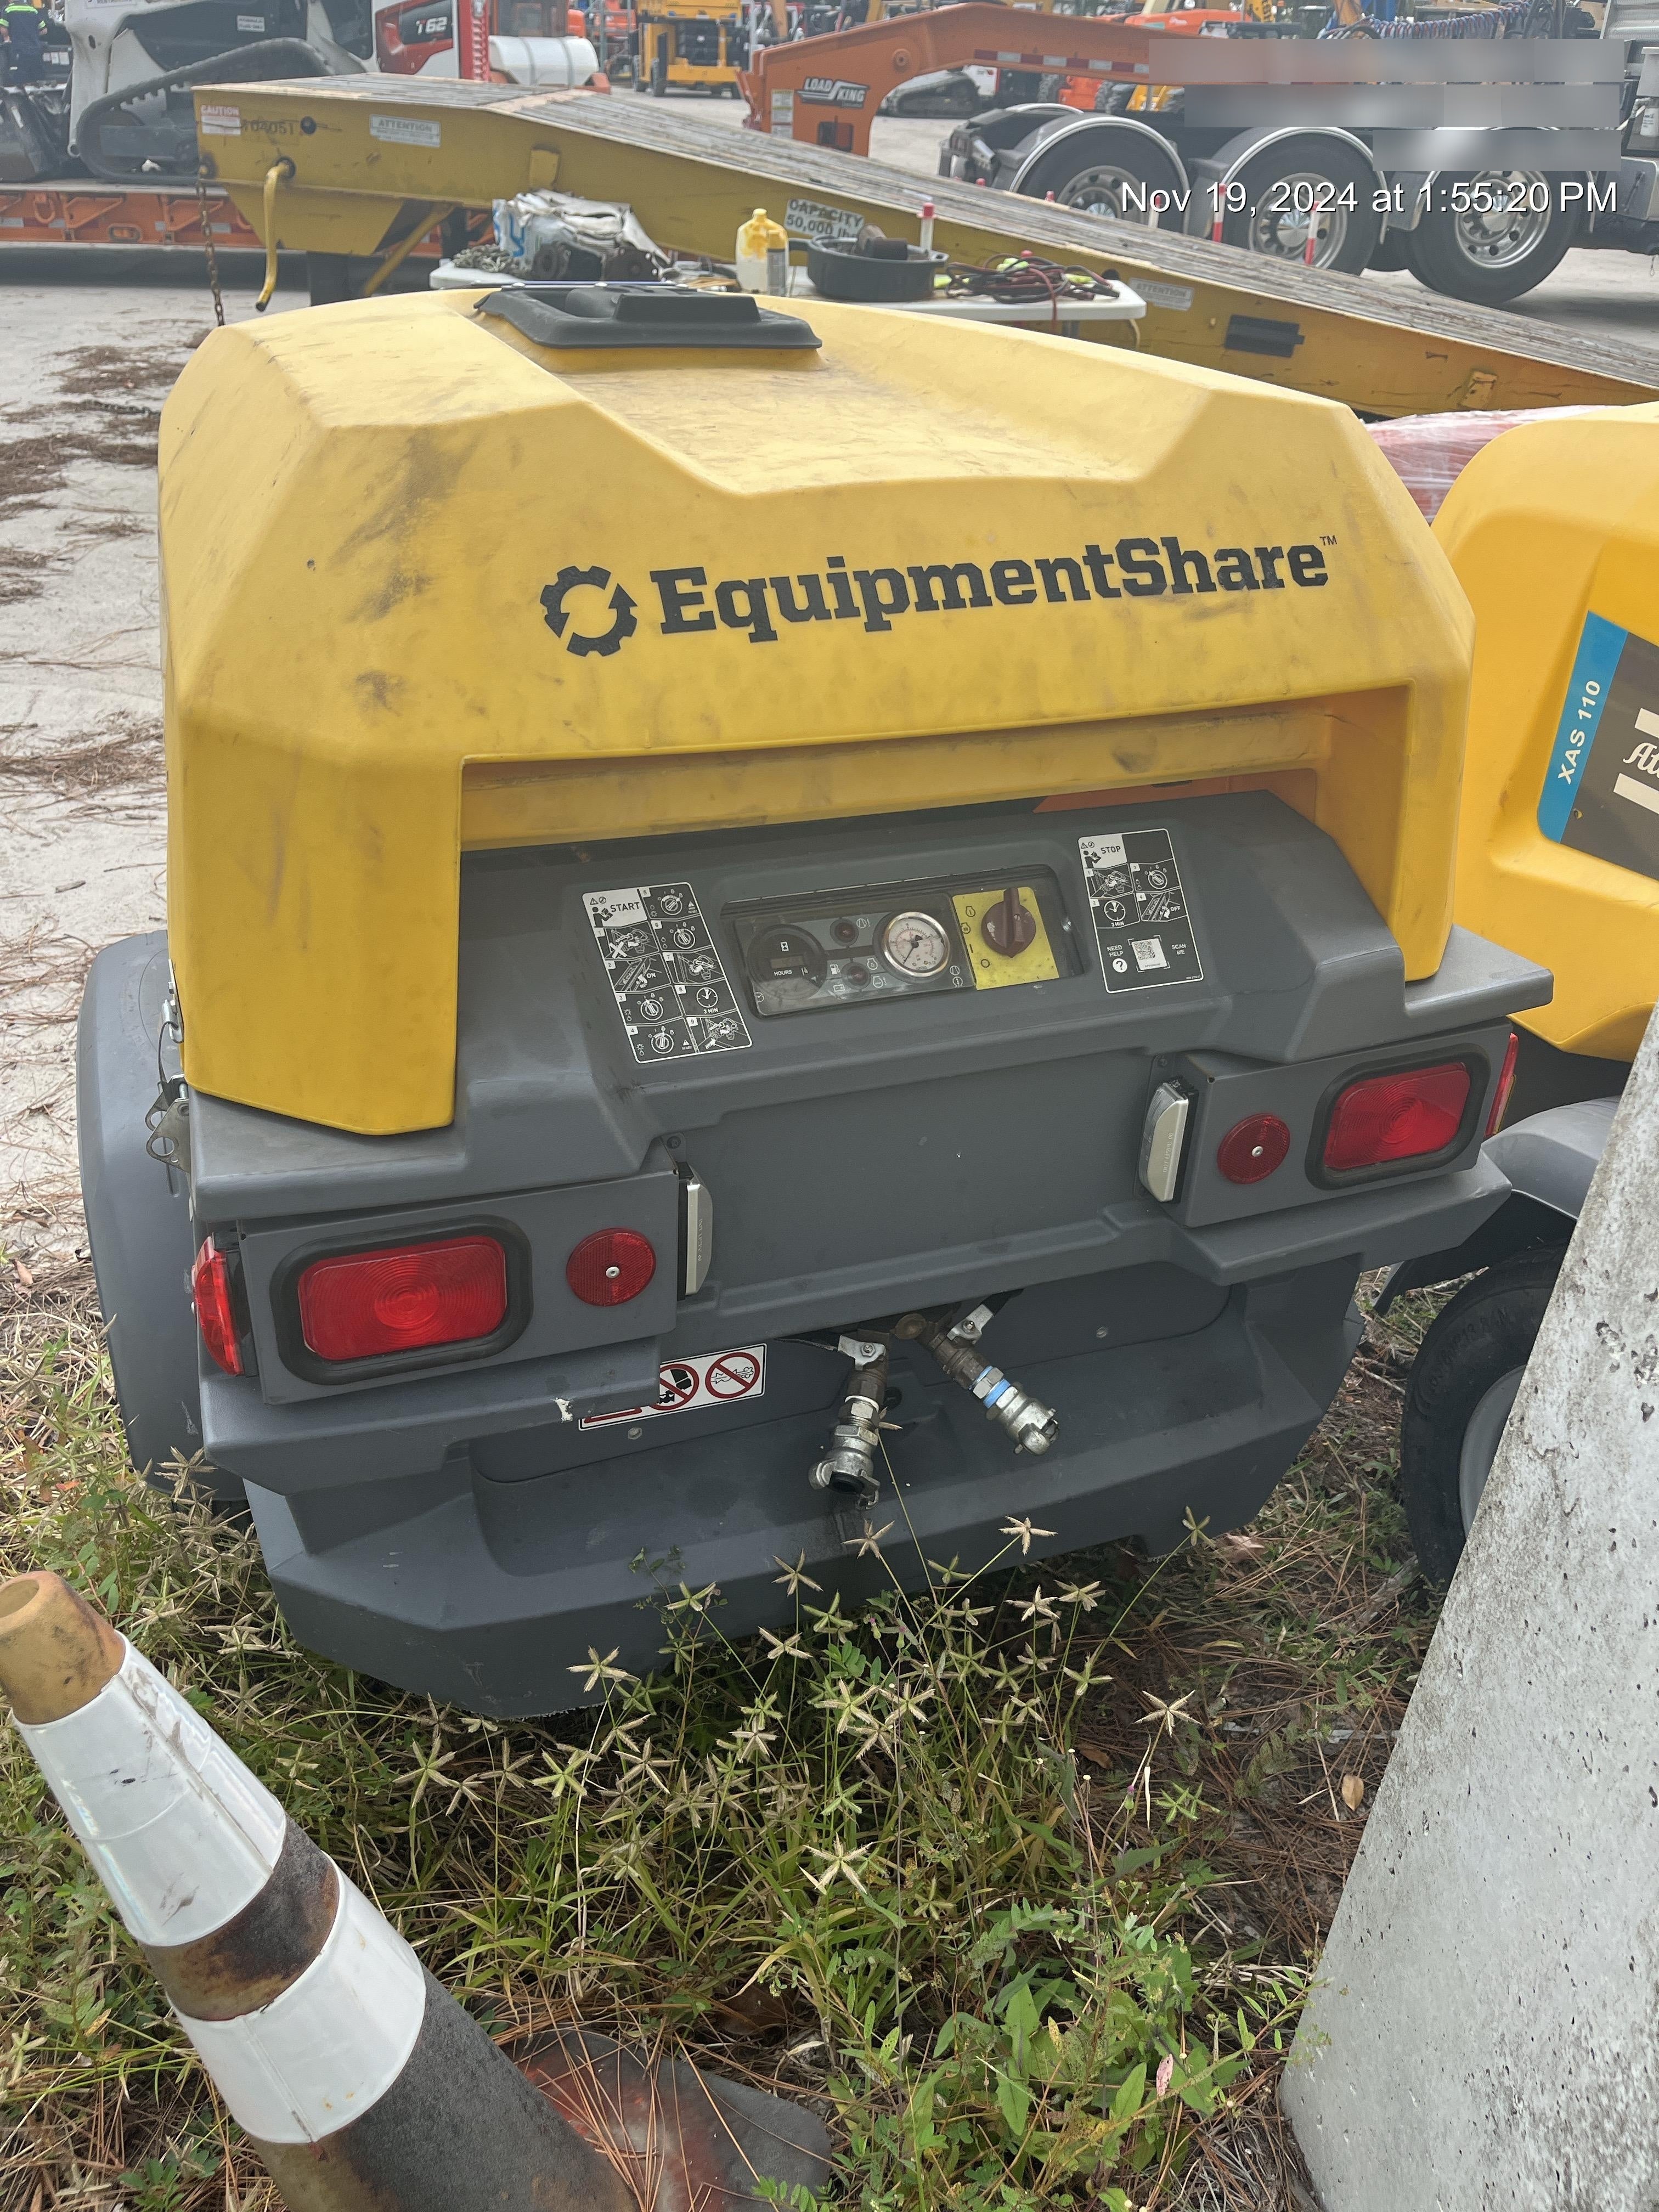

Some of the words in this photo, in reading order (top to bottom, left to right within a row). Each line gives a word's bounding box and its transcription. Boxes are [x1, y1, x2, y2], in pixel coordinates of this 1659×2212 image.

[416, 16, 448, 35] T62
[804, 78, 833, 92] LOAD
[836, 88, 866, 102] KING
[201, 105, 240, 116] CAUTION
[377, 118, 432, 132] ATTENTION
[789, 199, 864, 227] CAPACITY
[787, 214, 833, 235] 50,000
[650, 537, 1328, 643] EquipmentShare
[1558, 729, 1585, 785] XAS
[1577, 680, 1601, 720] 110
[1101, 845, 1121, 854] STOP
[610, 901, 640, 912] START
